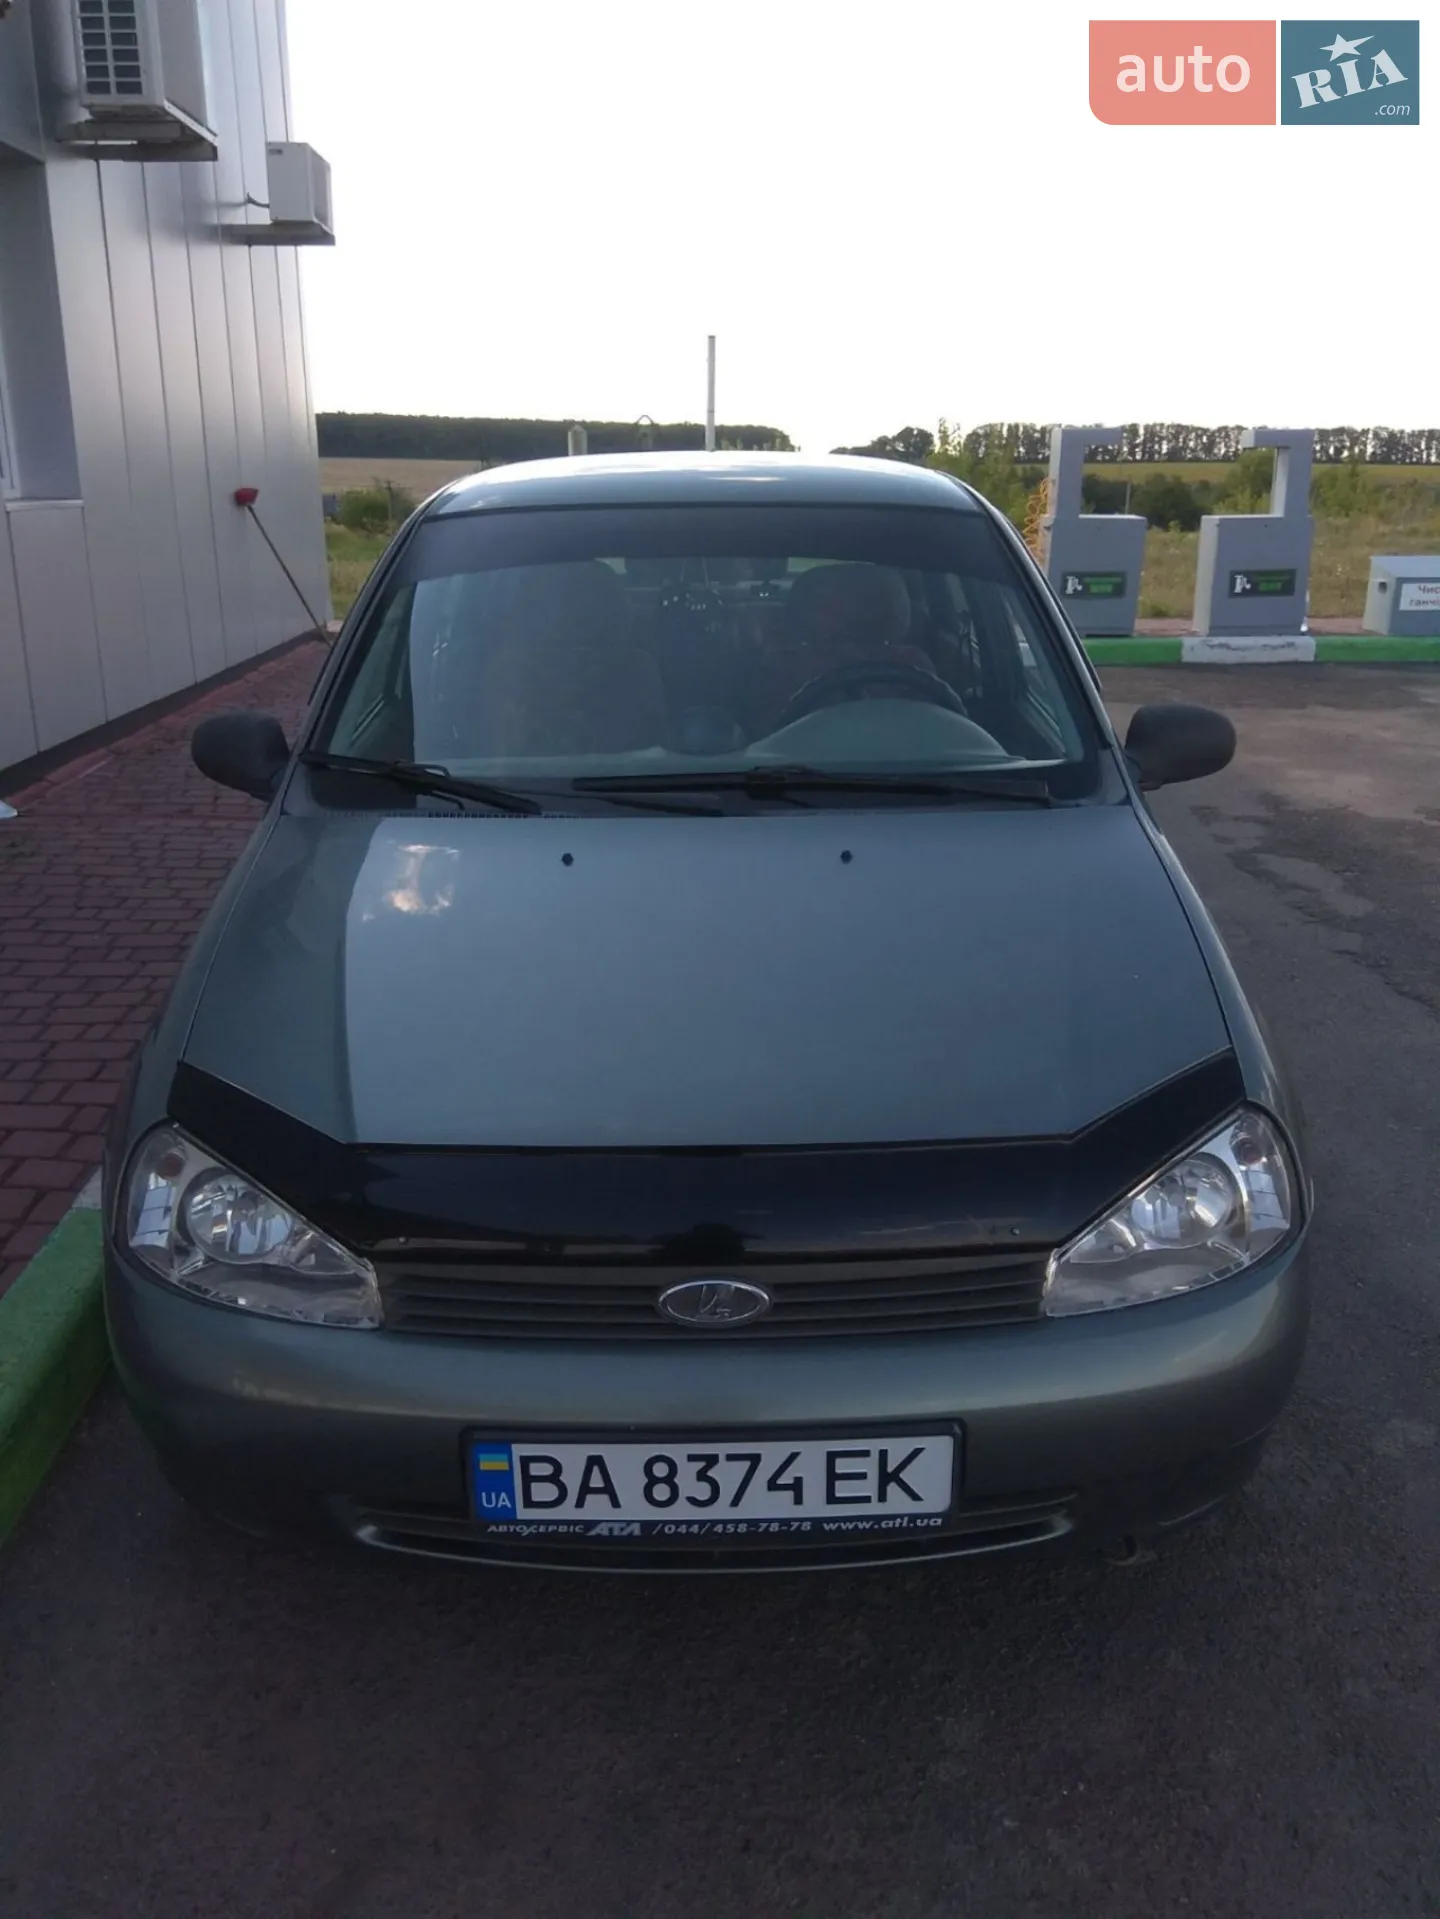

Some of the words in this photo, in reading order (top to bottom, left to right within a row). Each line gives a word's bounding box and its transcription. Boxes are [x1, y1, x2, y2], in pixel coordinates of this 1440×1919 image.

[519, 1454, 622, 1509] BA
[643, 1451, 804, 1509] 8374
[826, 1447, 926, 1505] EK
[481, 1492, 512, 1508] UA
[823, 1516, 943, 1532] www.atl.ua
